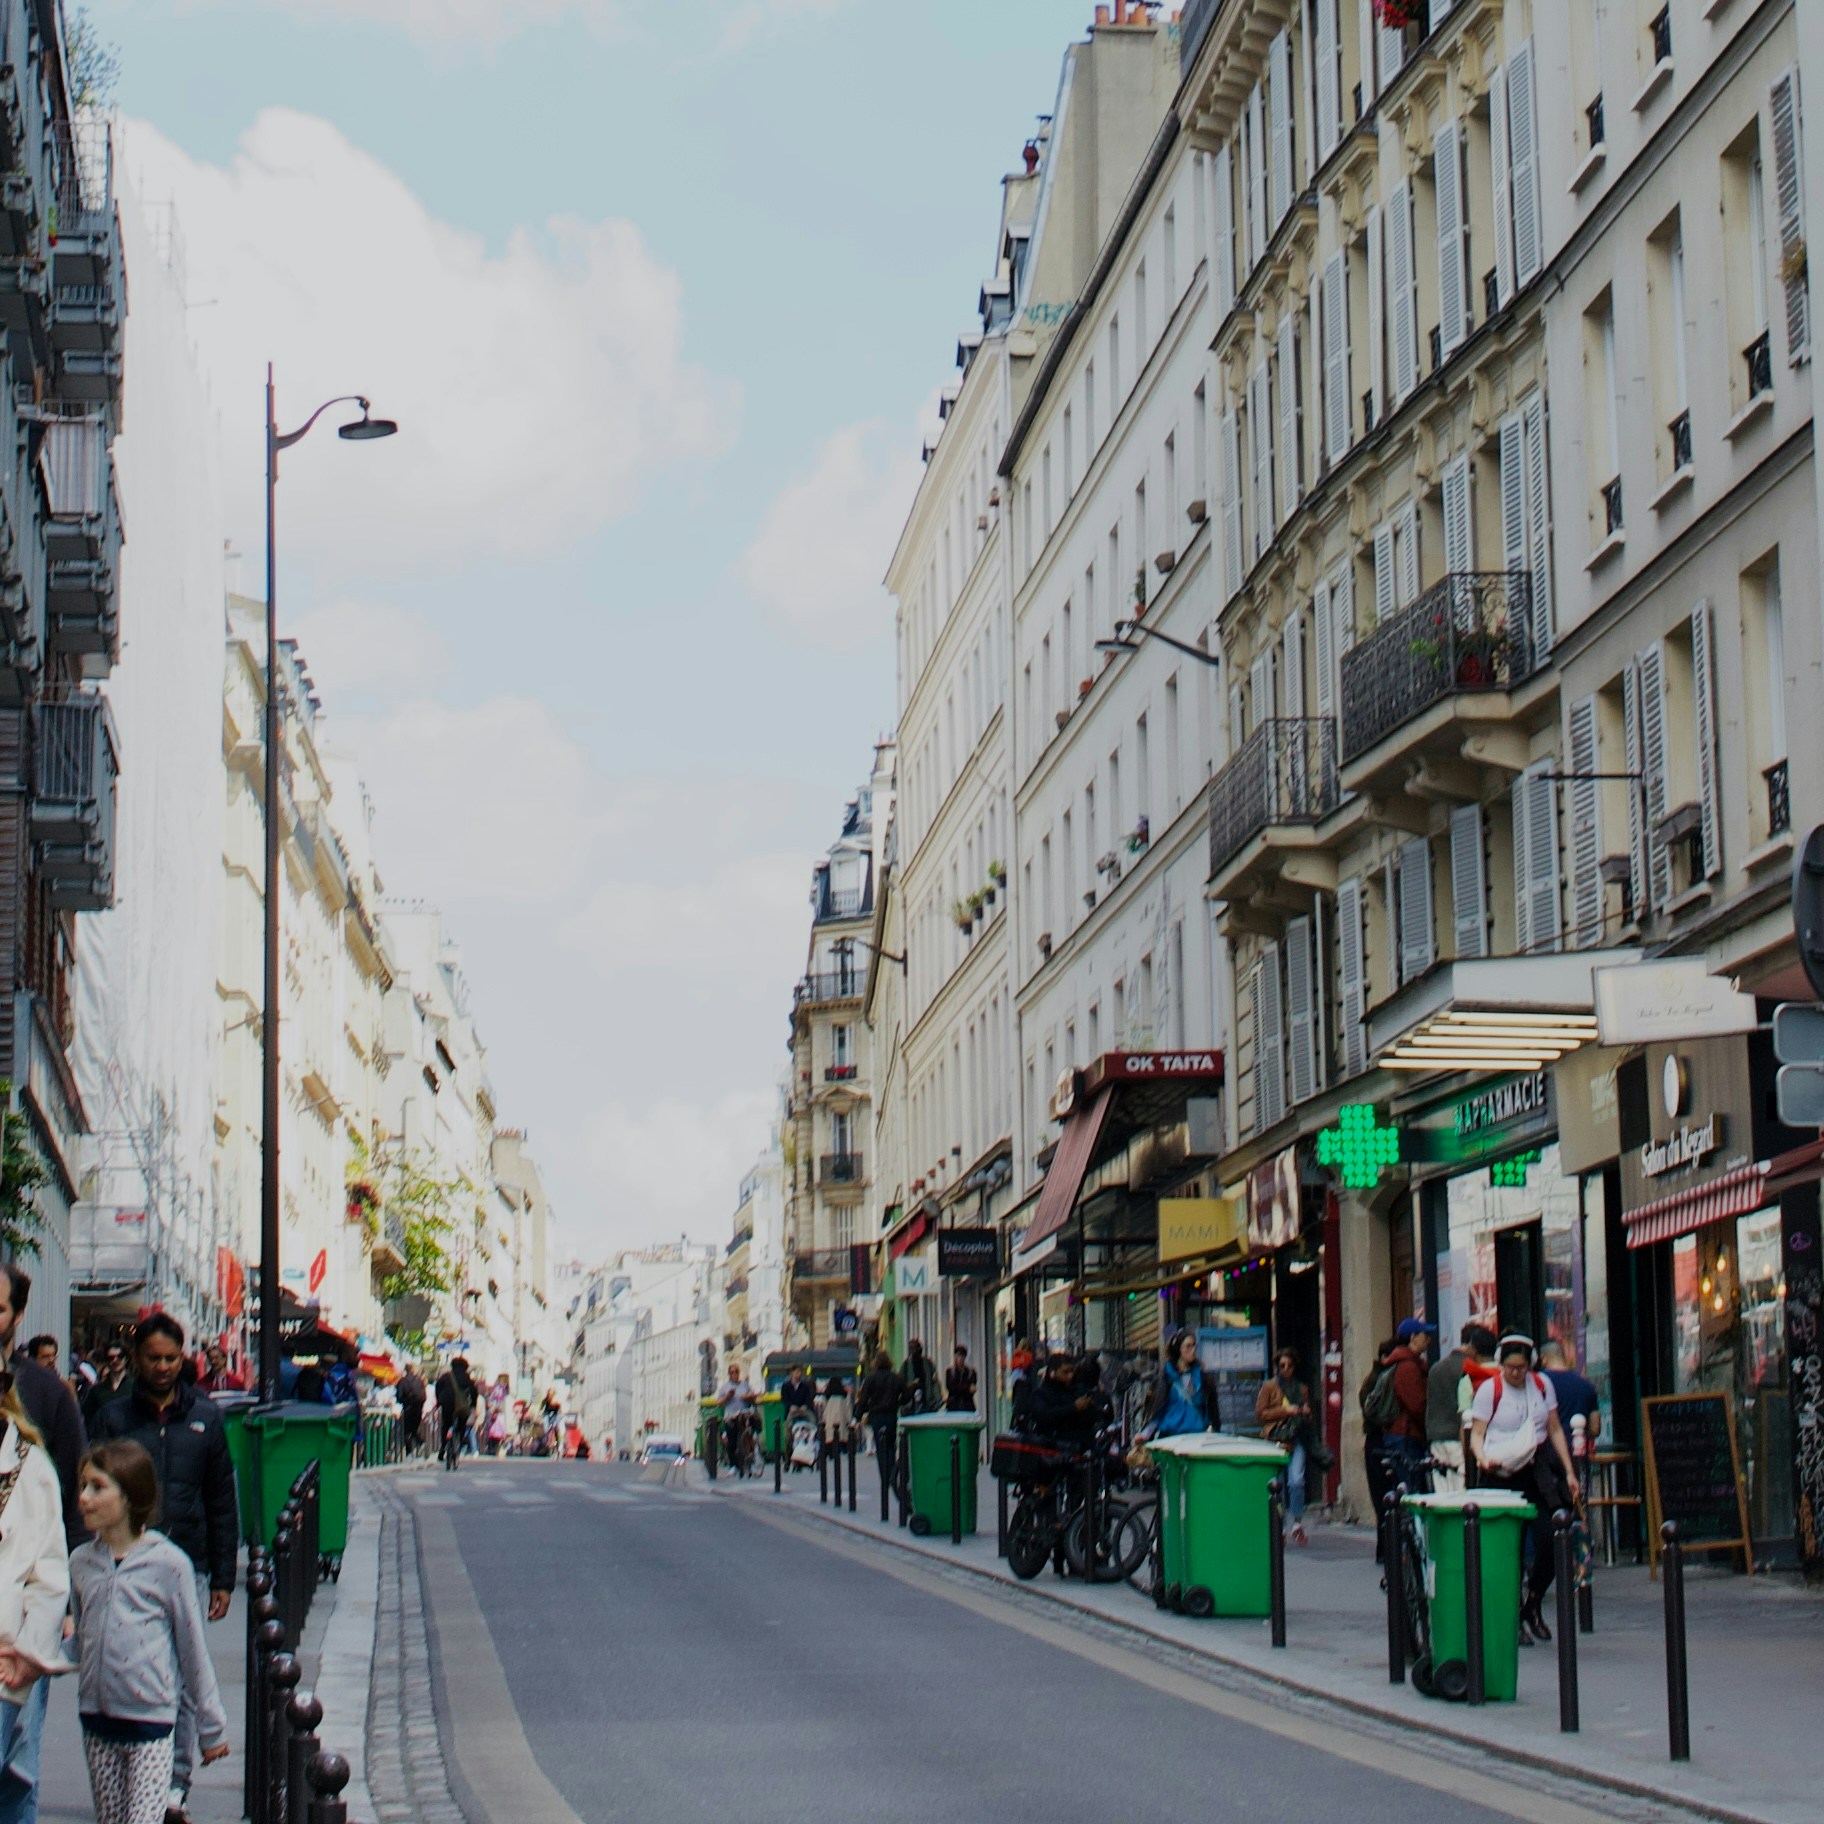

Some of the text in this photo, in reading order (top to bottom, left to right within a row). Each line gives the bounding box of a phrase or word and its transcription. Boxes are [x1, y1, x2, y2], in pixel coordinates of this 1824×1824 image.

[1126, 1054, 1215, 1073] OK TAITA
[1641, 1136, 1666, 1179] Salon
[1681, 1111, 1715, 1171] Regard
[1168, 1224, 1220, 1241] MAMI
[902, 1264, 925, 1288] M
